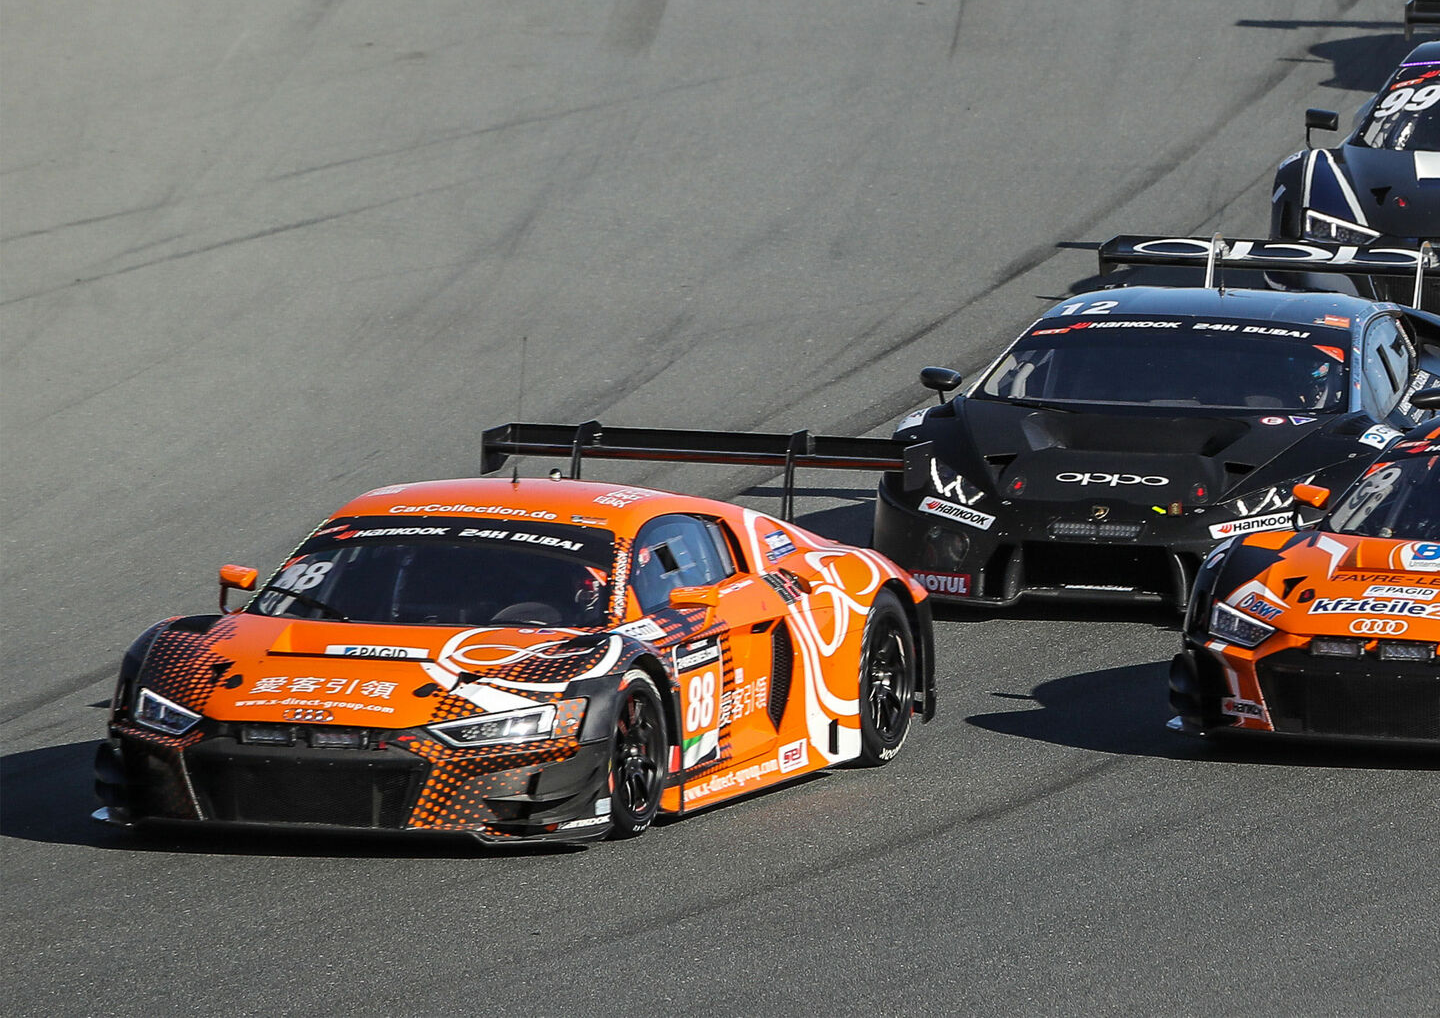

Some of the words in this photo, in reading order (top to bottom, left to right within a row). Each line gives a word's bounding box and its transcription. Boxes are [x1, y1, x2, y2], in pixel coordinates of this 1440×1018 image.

[1060, 300, 1120, 316] 12
[1192, 322, 1239, 332] 24H
[1241, 325, 1312, 339] DUBAI
[1055, 471, 1170, 488] oppo
[388, 502, 558, 521] CarCollection.de
[457, 528, 508, 540] 24H
[510, 532, 585, 552] DUBAI
[913, 573, 968, 594] MOTUL
[1384, 585, 1436, 598] PAGID
[1251, 599, 1286, 622] BWT
[360, 646, 409, 659] PAGID
[248, 675, 399, 700] 愛客引領
[234, 697, 396, 715] www.x-direct-group.com
[686, 670, 716, 733] 88
